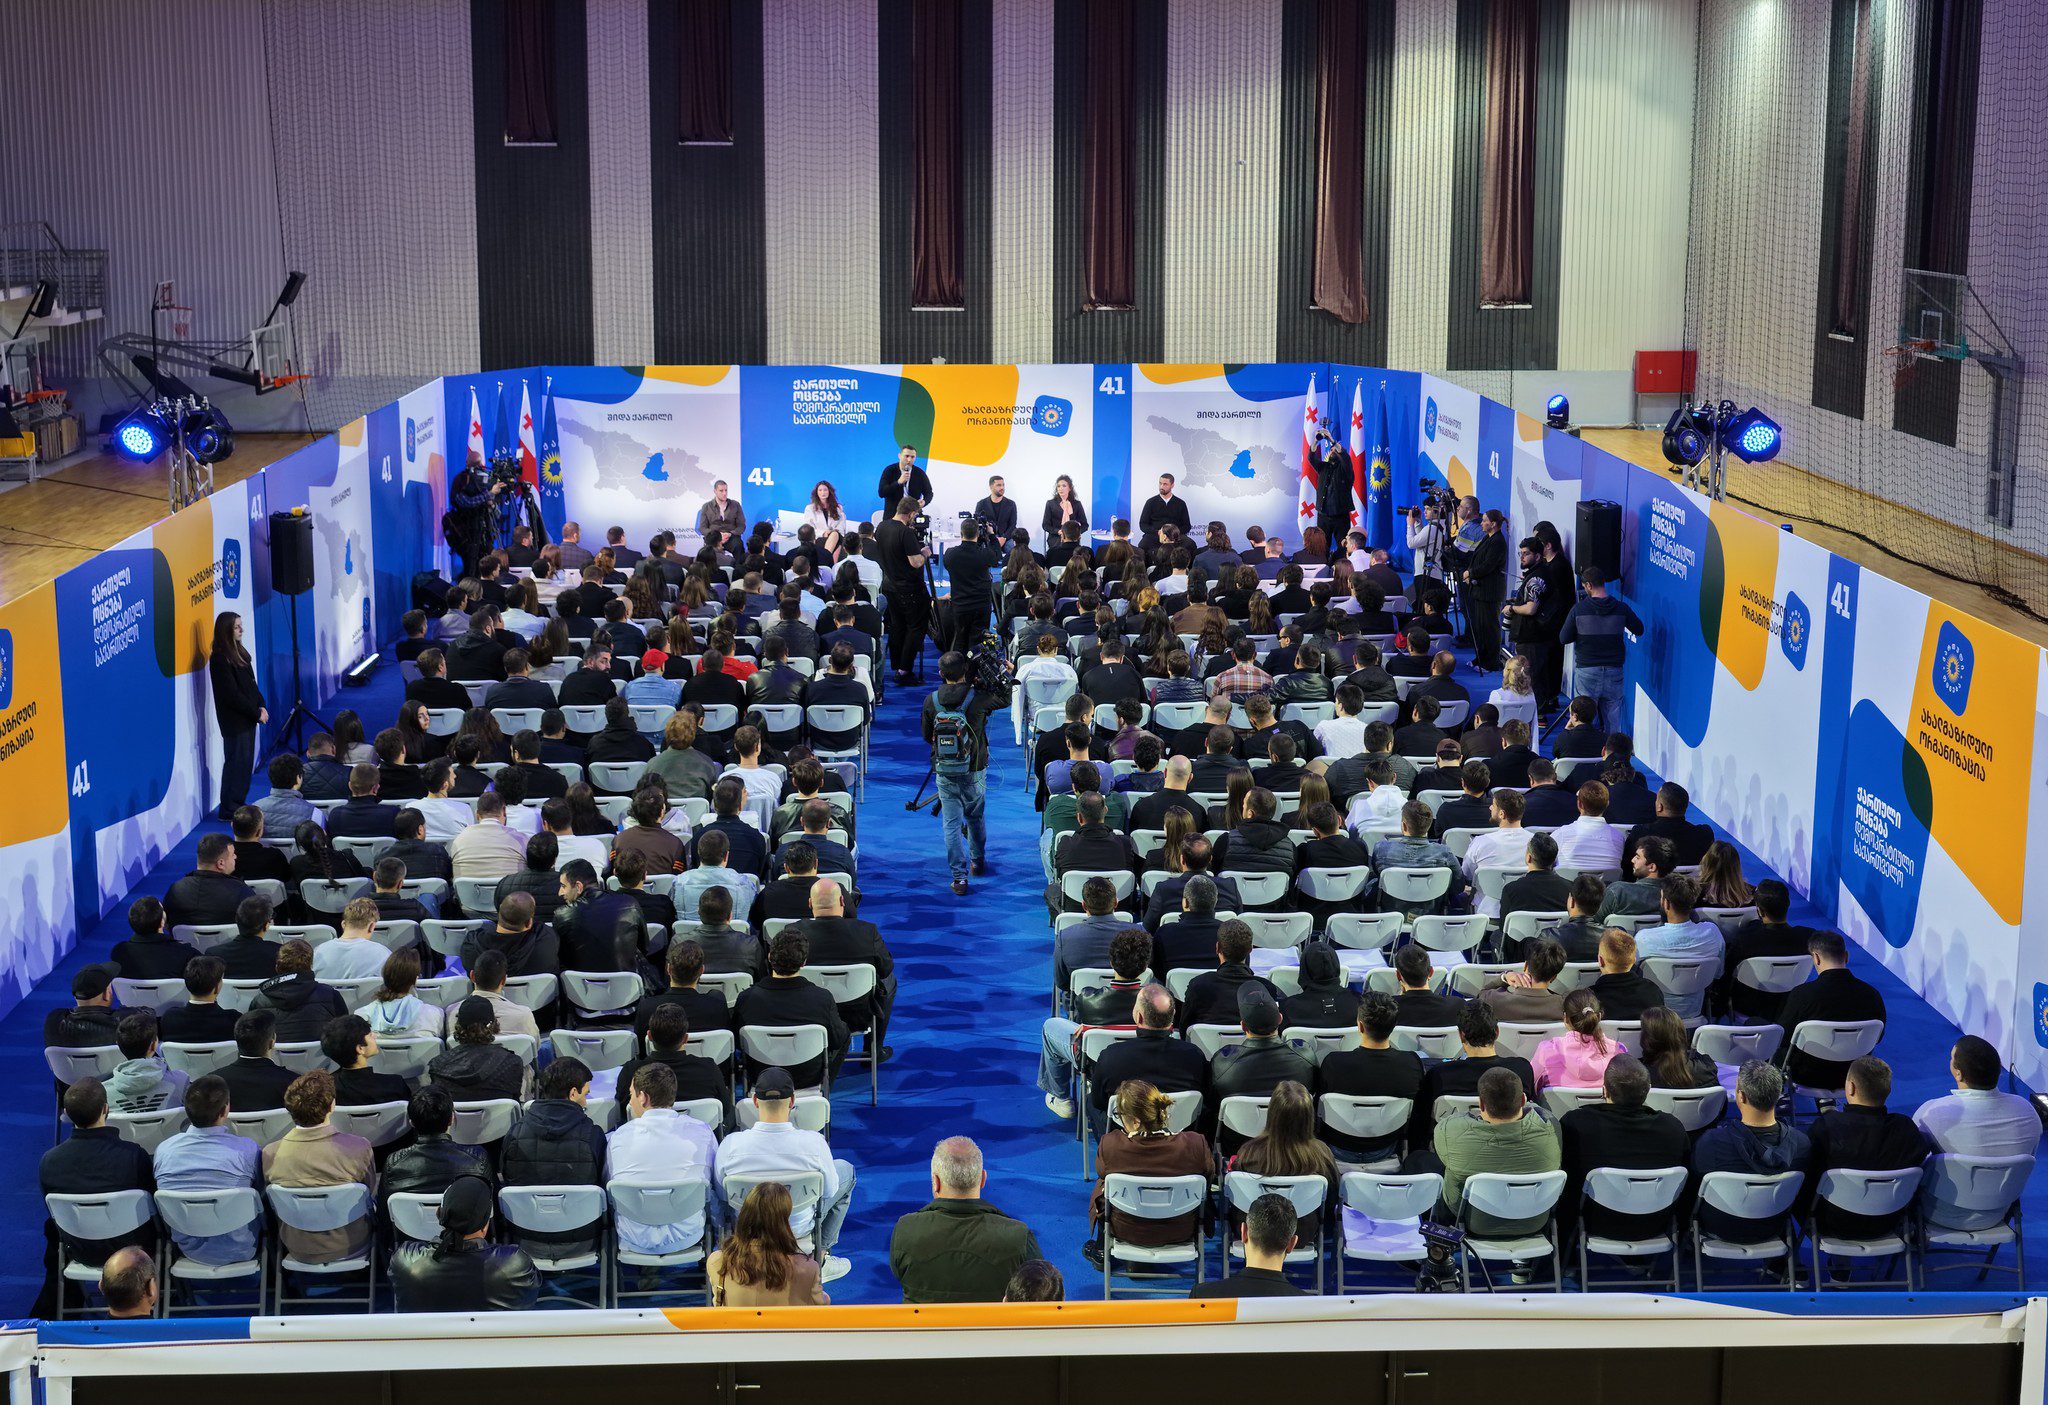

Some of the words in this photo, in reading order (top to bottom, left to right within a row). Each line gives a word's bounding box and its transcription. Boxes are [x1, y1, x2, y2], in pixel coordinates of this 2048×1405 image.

[793, 379, 858, 390] ქართული
[793, 391, 842, 401] ოცნება
[1099, 376, 1126, 395] 41
[793, 402, 880, 413] დემოკრატიული
[793, 414, 867, 425] საქართველო
[961, 406, 1038, 414] ახალგაზრდული
[967, 417, 1038, 426] ორგანიზაცია
[1196, 411, 1220, 419] შიდა
[1221, 411, 1262, 419] ქართლი
[381, 455, 393, 484] 41
[747, 467, 775, 486] 41
[1489, 450, 1500, 480] 41
[250, 493, 264, 522] 41
[91, 566, 131, 605] ქართული
[1830, 581, 1851, 620] 41
[0, 700, 37, 740] აზრდული
[1920, 707, 1993, 763] ახალგაზრდული
[1919, 730, 1986, 782] ორგანიზაცია
[72, 760, 91, 798] 41
[1855, 803, 1889, 839] ოცნება
[1856, 786, 1902, 830] ქართული
[1853, 837, 1904, 889] საქართველო
[1854, 820, 1915, 877] დემოკრატიული
